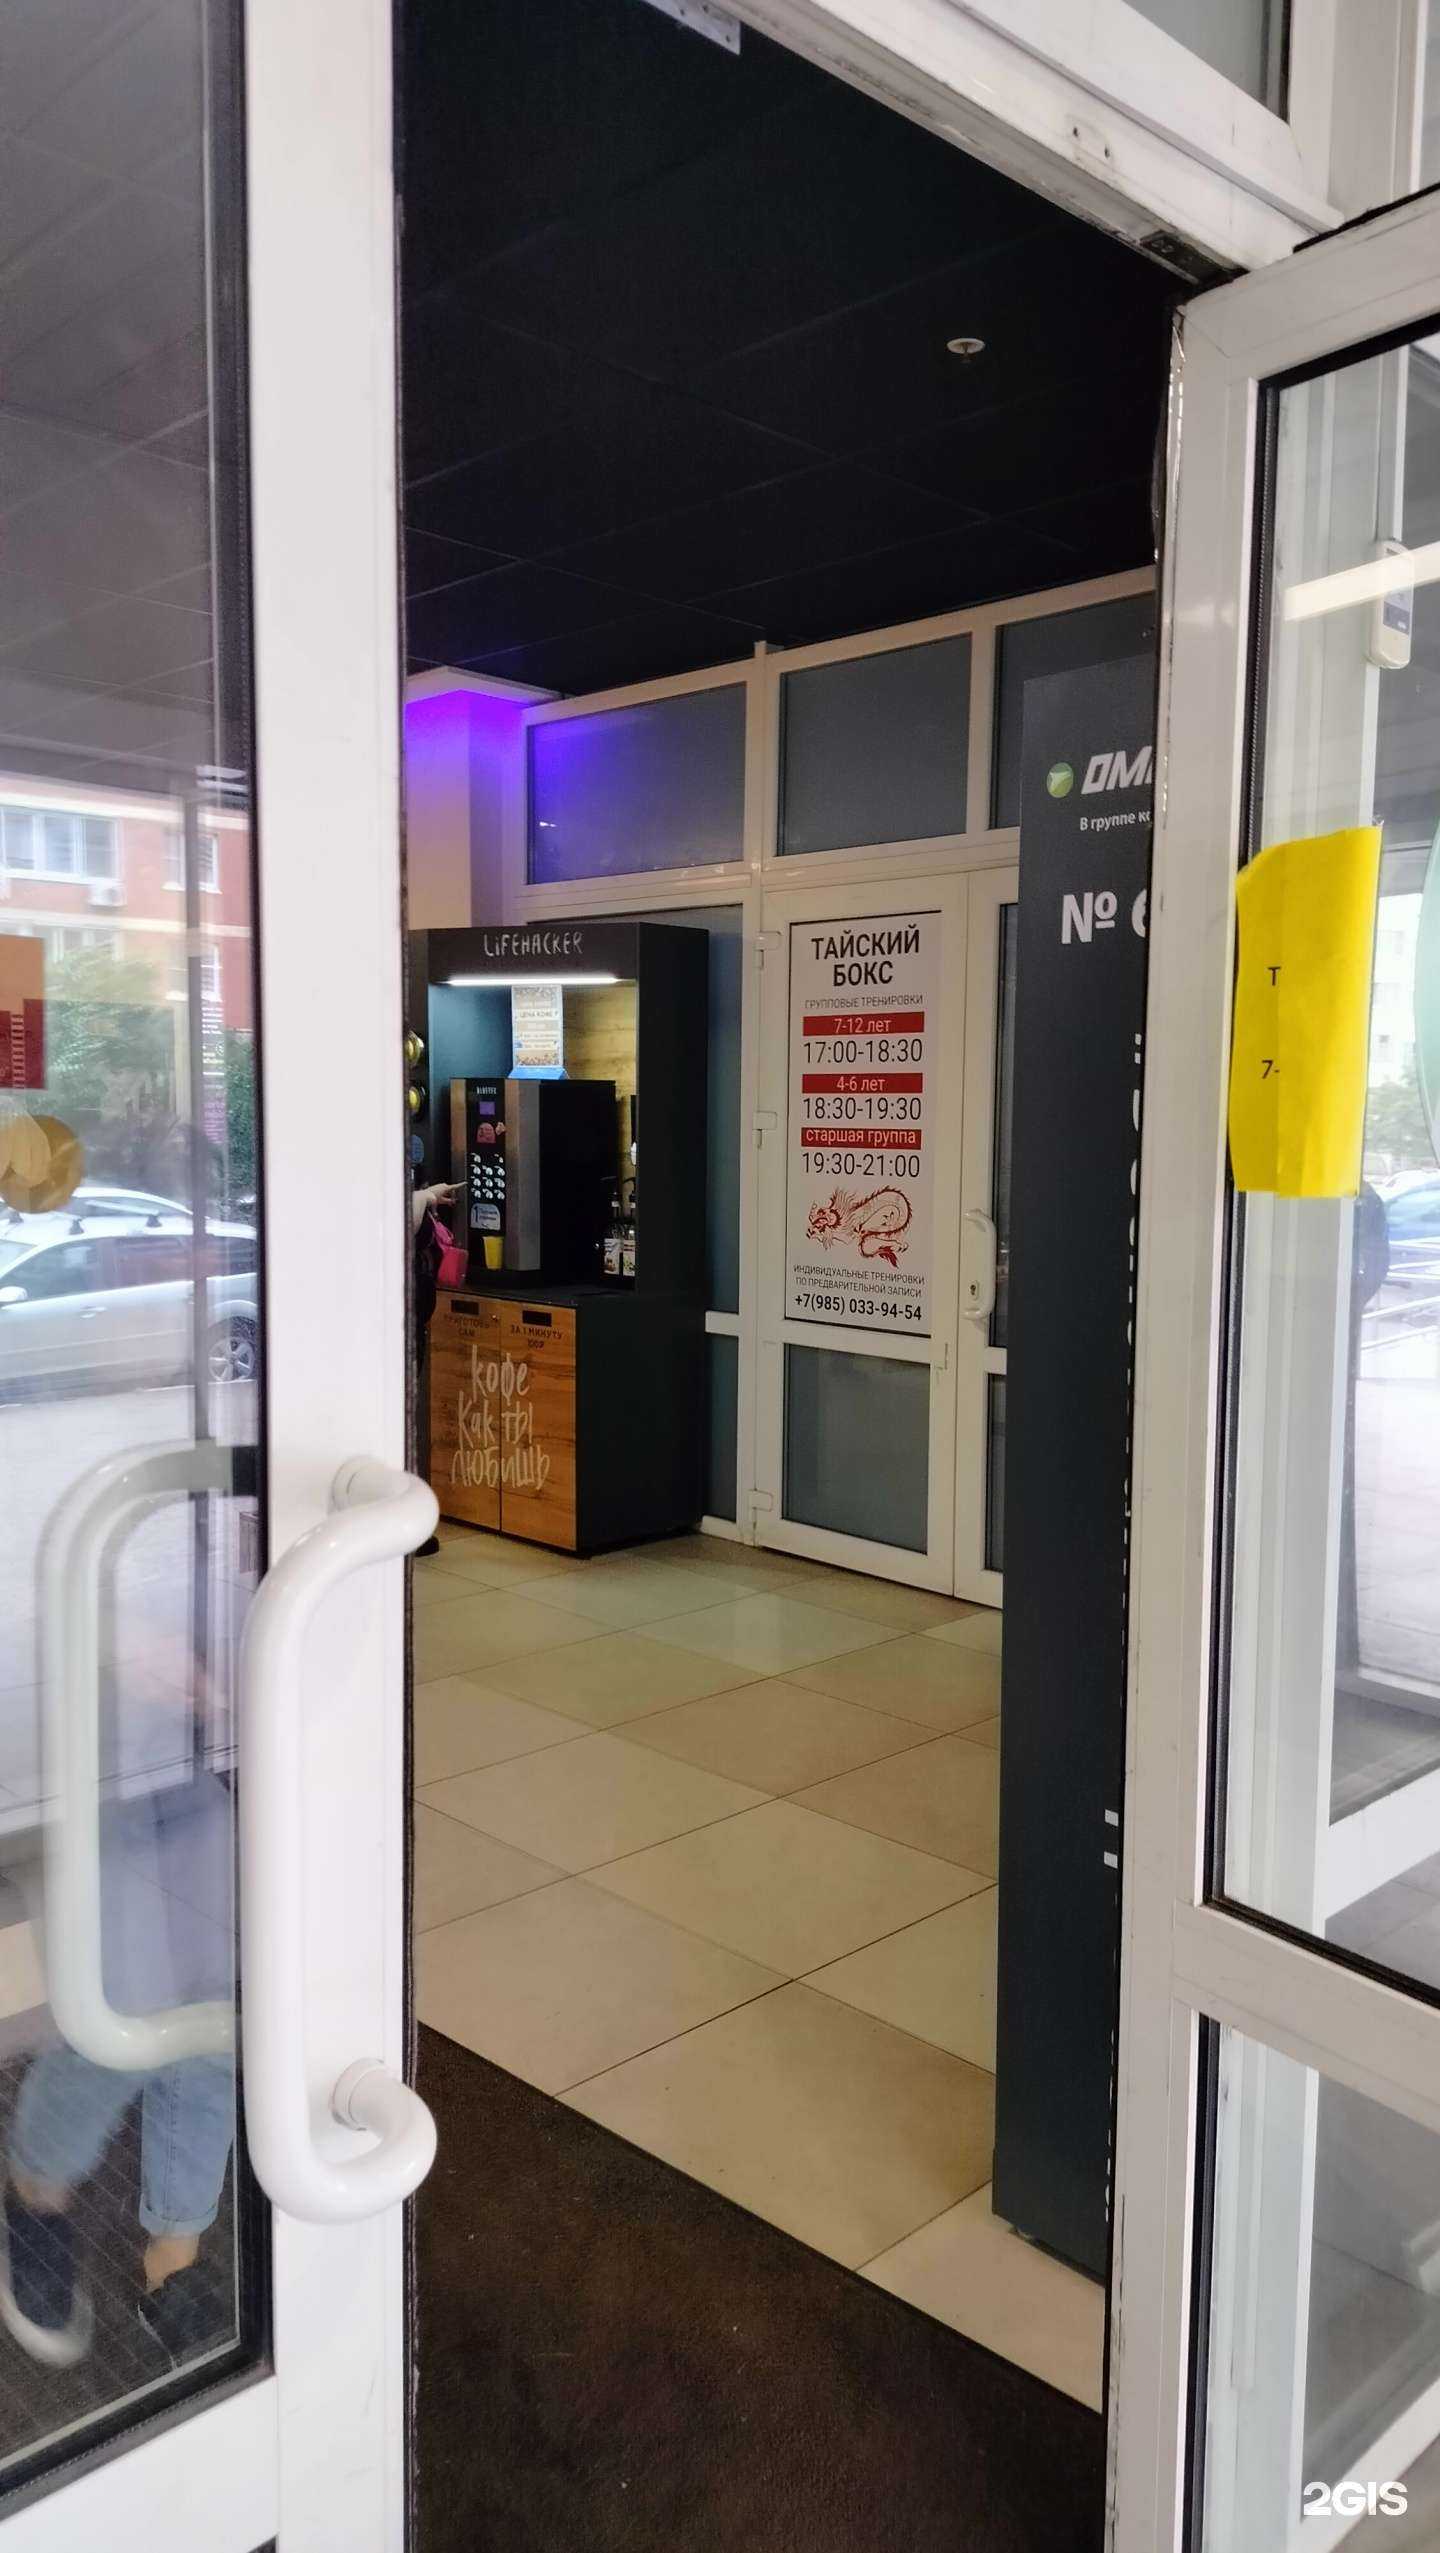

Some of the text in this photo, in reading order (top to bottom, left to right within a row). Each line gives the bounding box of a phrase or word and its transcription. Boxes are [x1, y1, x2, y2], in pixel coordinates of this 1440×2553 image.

[1080, 817, 1088, 831] В
[1090, 812, 1136, 832] группе
[1061, 891, 1118, 944] №
[811, 923, 920, 960] ТАЙСКИЙ
[833, 961, 893, 987] БОКС
[805, 994, 923, 1009] ГРУППОВЫЕ ТРЕНИРОВКИ
[834, 1017, 892, 1034] 7-12 лет
[803, 1038, 923, 1064] 17:00-18:30
[837, 1076, 886, 1091] 4-6 лет
[803, 1097, 922, 1121] 18:30-19:30
[806, 1128, 916, 1147] старшая группа
[802, 1152, 920, 1178] 19:30-21:00
[793, 1264, 925, 1286] ИНДИВИДУАЛЬНЫЕ ТРЕНИРОВКИ
[796, 1277, 922, 1298] ПО ПРЕДВАРИТЕЛЬНОЙ ЗАПИСИ
[795, 1293, 922, 1321] +7(985) 033-94-54
[451, 1444, 550, 1490] любишь
